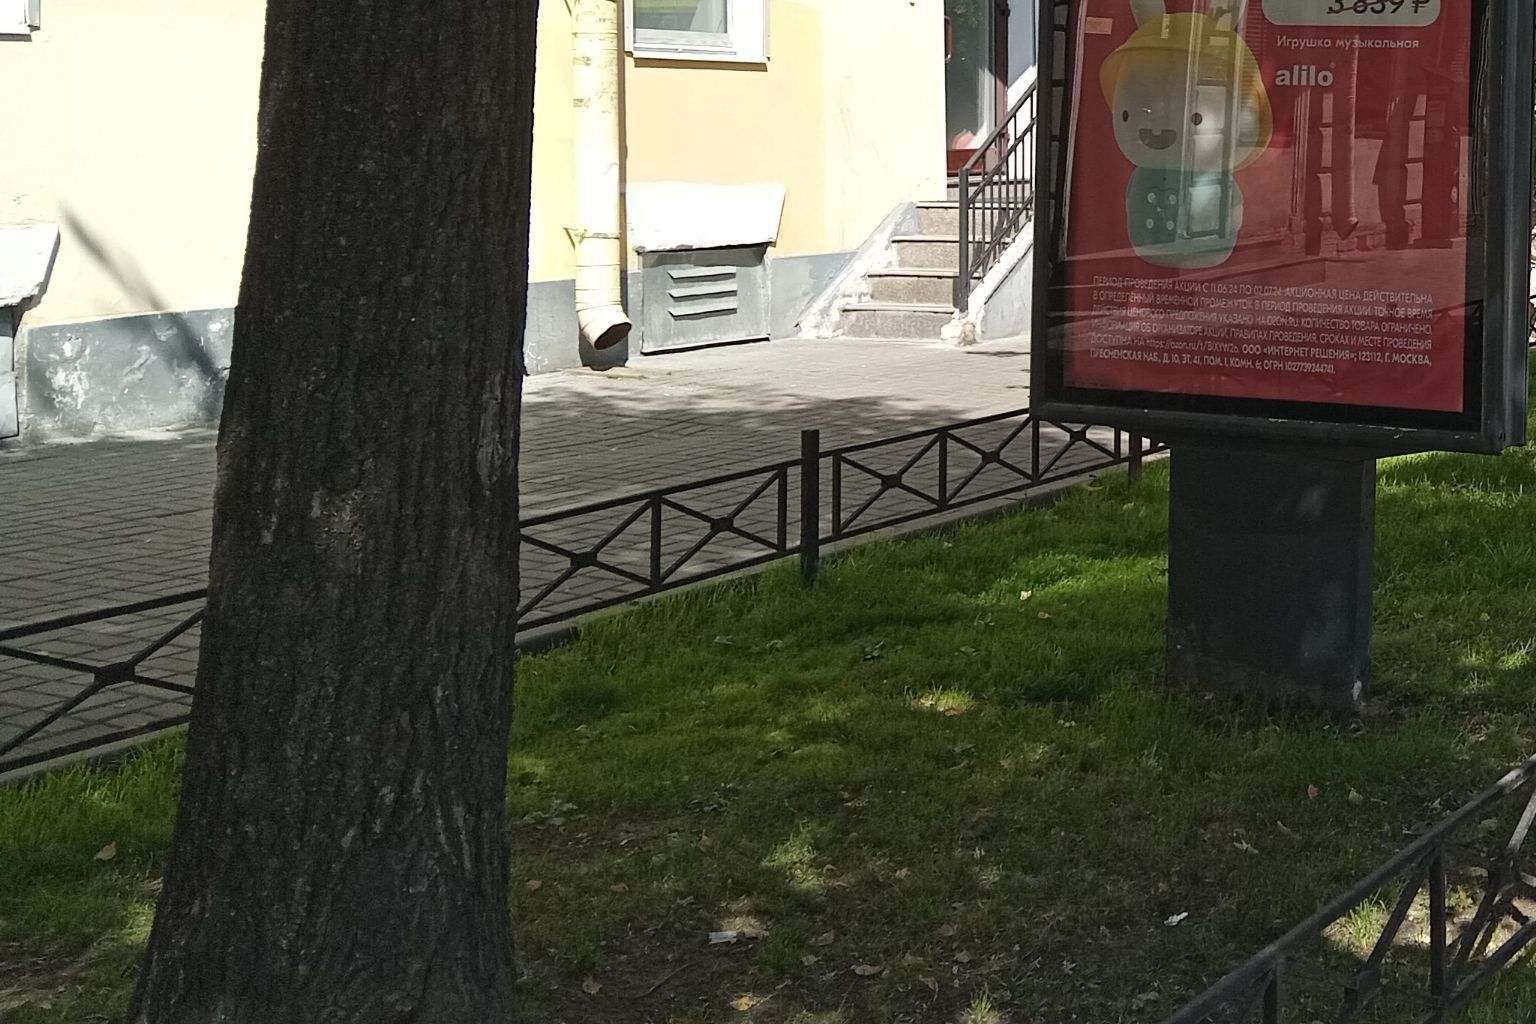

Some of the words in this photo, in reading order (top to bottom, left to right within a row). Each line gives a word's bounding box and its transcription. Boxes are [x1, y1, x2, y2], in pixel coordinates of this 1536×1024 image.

[1277, 36, 1331, 52] Игрушка
[1336, 39, 1419, 52] музыкальная
[1275, 65, 1334, 87] alilo
[1338, 288, 1360, 299] ЦЕНА
[1362, 289, 1433, 303] ДЕЙСТВИТЕЛЬНА
[1392, 352, 1431, 366] МОСКВА,
